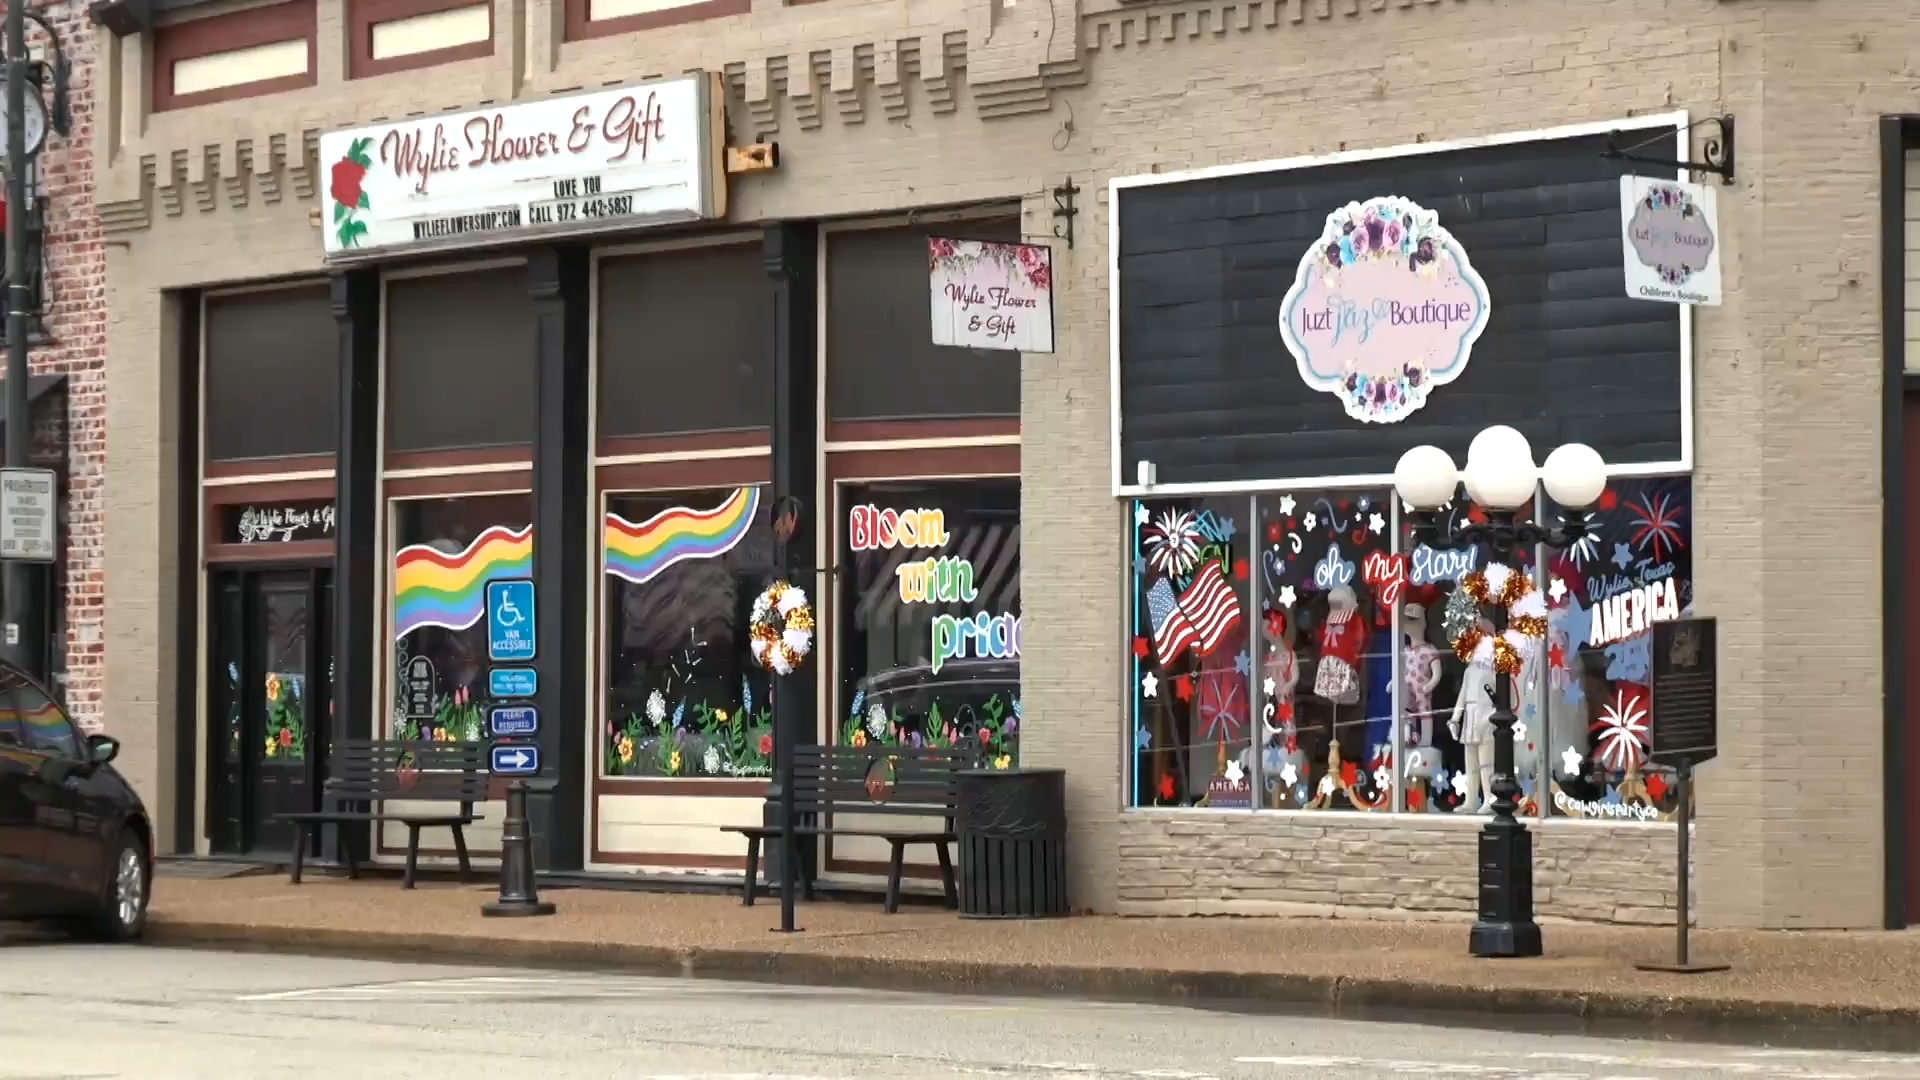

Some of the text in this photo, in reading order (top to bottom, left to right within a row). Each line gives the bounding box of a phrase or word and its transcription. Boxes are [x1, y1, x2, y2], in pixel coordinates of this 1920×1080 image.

[380, 91, 666, 195] Wylie Flower & Gift
[554, 175, 601, 199] LOVE YOU
[528, 206, 552, 225] CALL
[557, 203, 577, 222] 972
[944, 282, 1037, 312] Wylie Flower
[967, 314, 1016, 342] & Gift
[1302, 306, 1333, 336] Juzt
[1390, 298, 1471, 330] Boutique
[850, 503, 950, 551] Bloom
[896, 555, 978, 604] with
[1315, 543, 1355, 588] oh
[1362, 549, 1407, 605] my
[1587, 573, 1633, 601] Wylie
[1589, 576, 1679, 648] AMERICA
